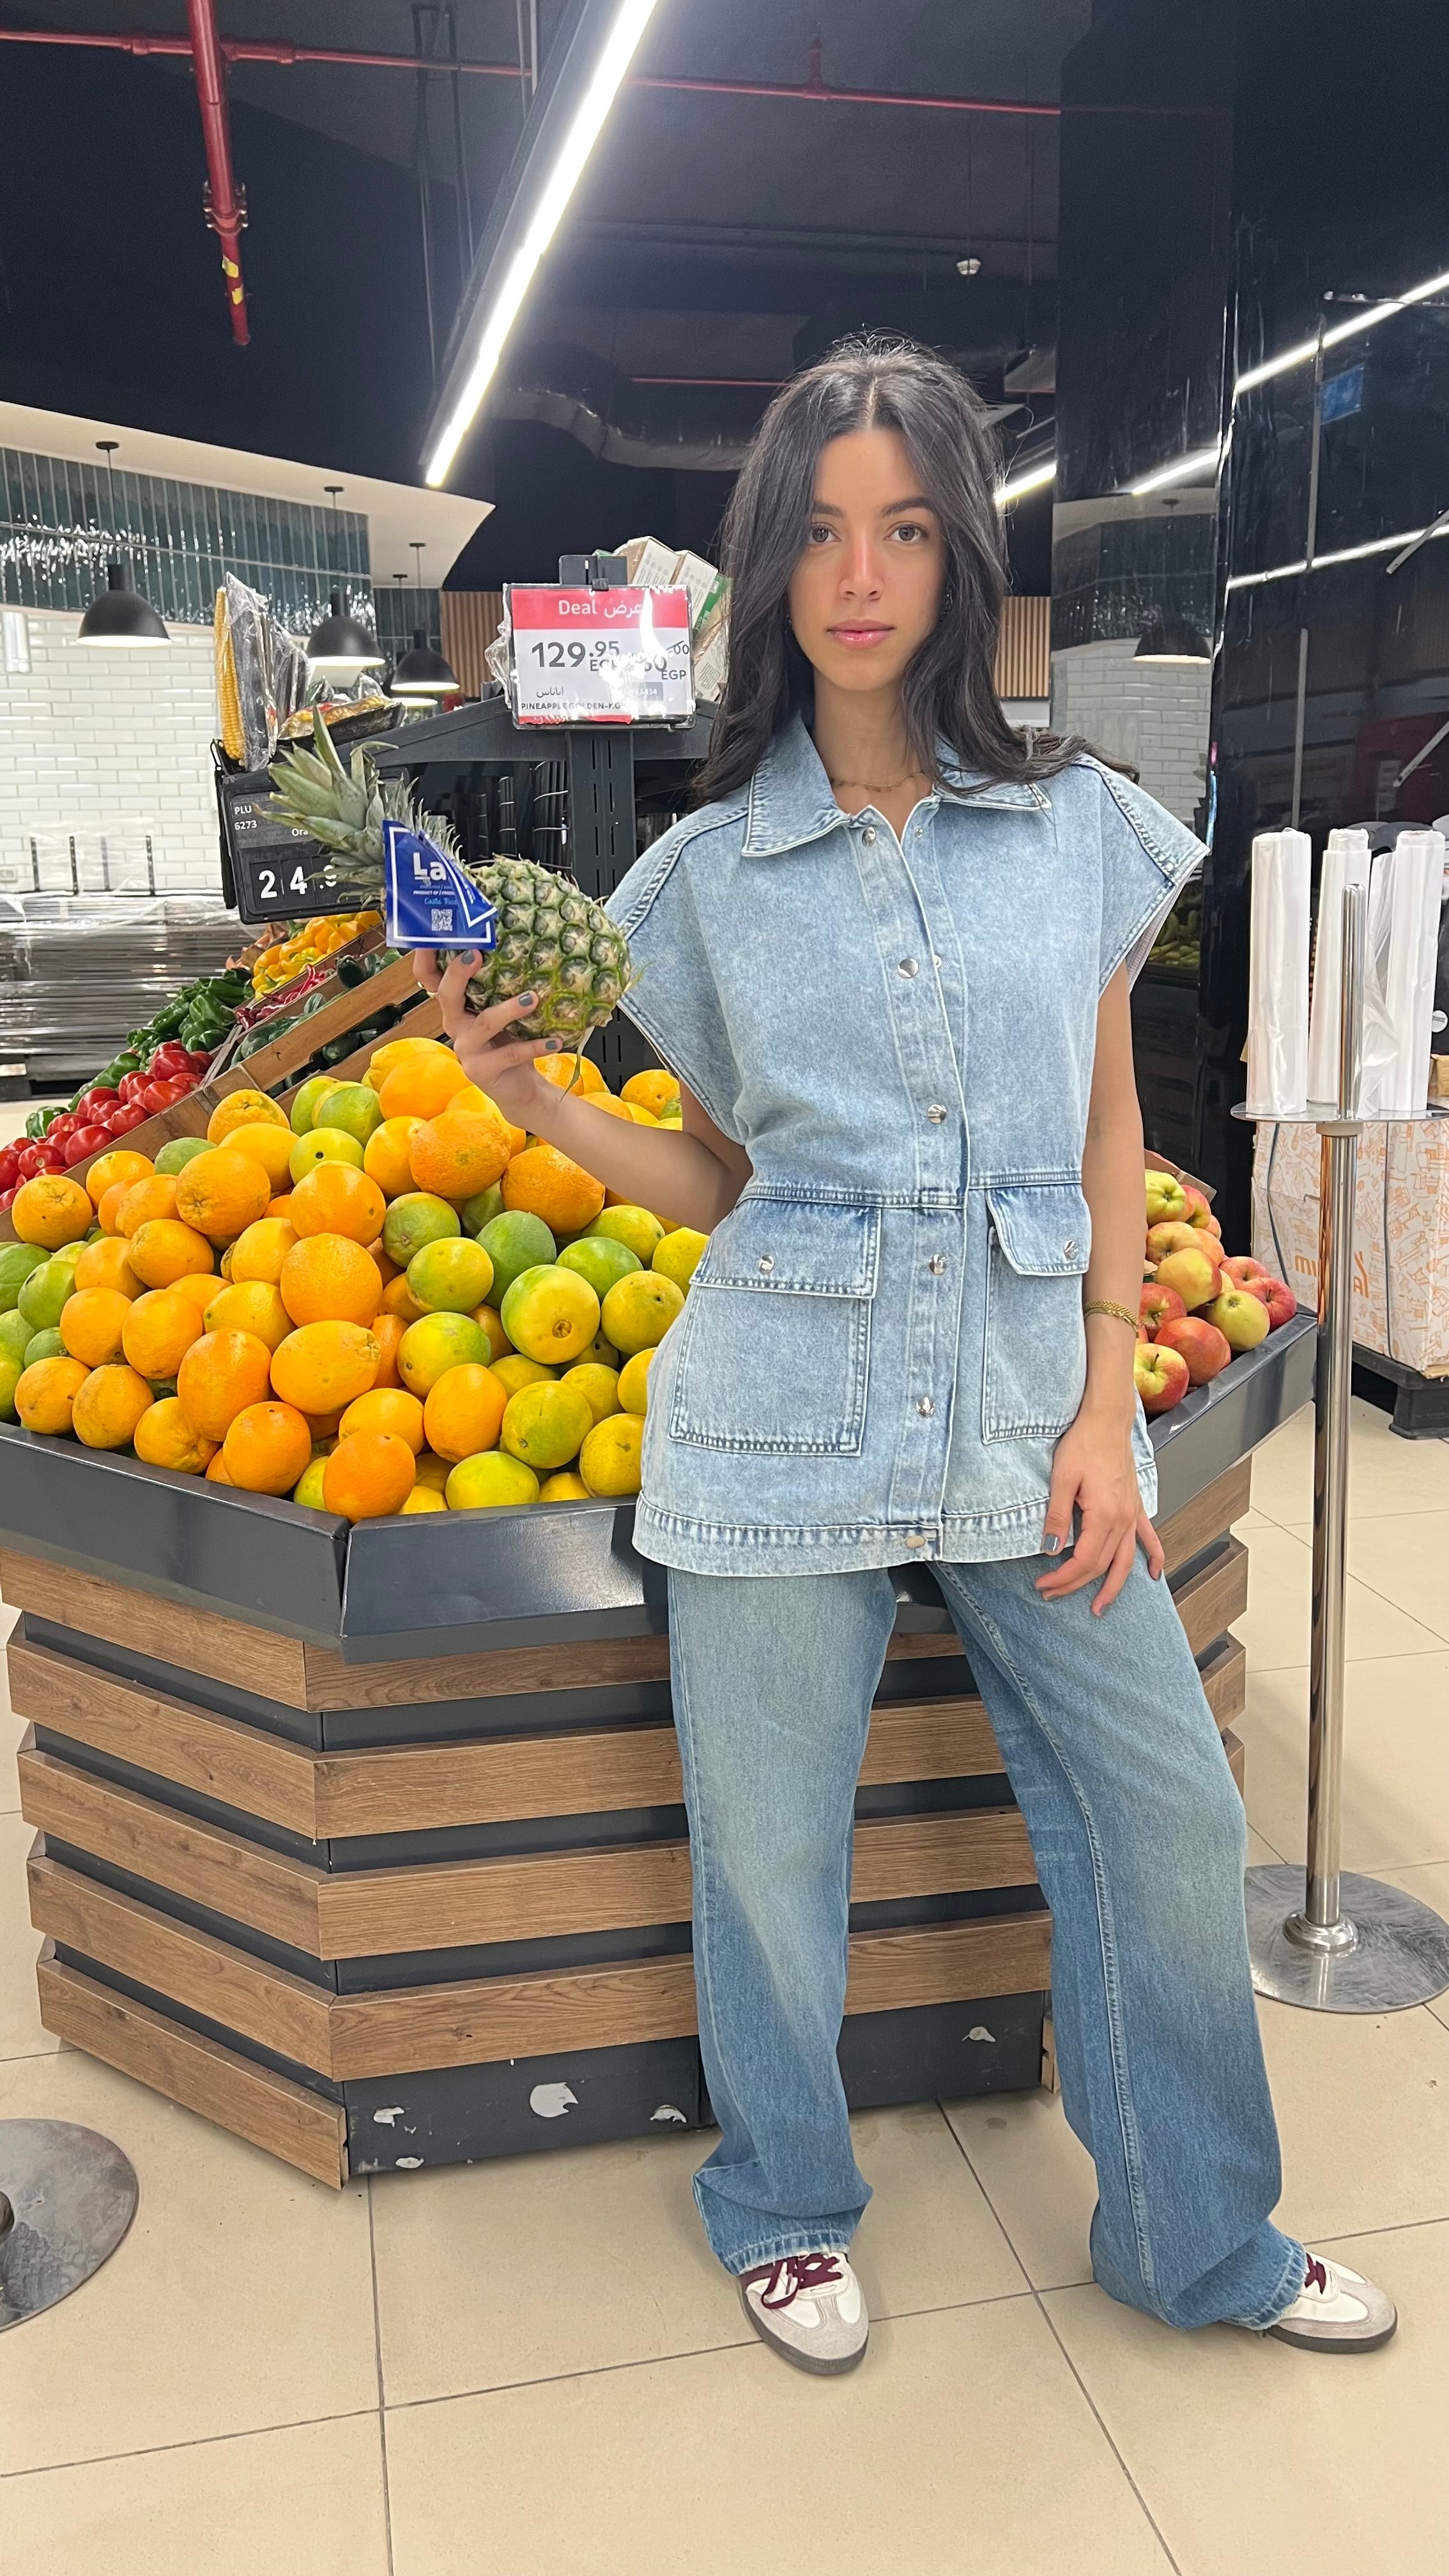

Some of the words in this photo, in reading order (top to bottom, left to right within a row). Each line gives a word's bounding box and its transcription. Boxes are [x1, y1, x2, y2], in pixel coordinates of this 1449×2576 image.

[558, 599, 597, 615] Deal
[661, 670, 686, 680] EGP
[234, 805, 252, 815] PLU
[234, 820, 257, 831] 6273
[291, 827, 309, 837] Ora
